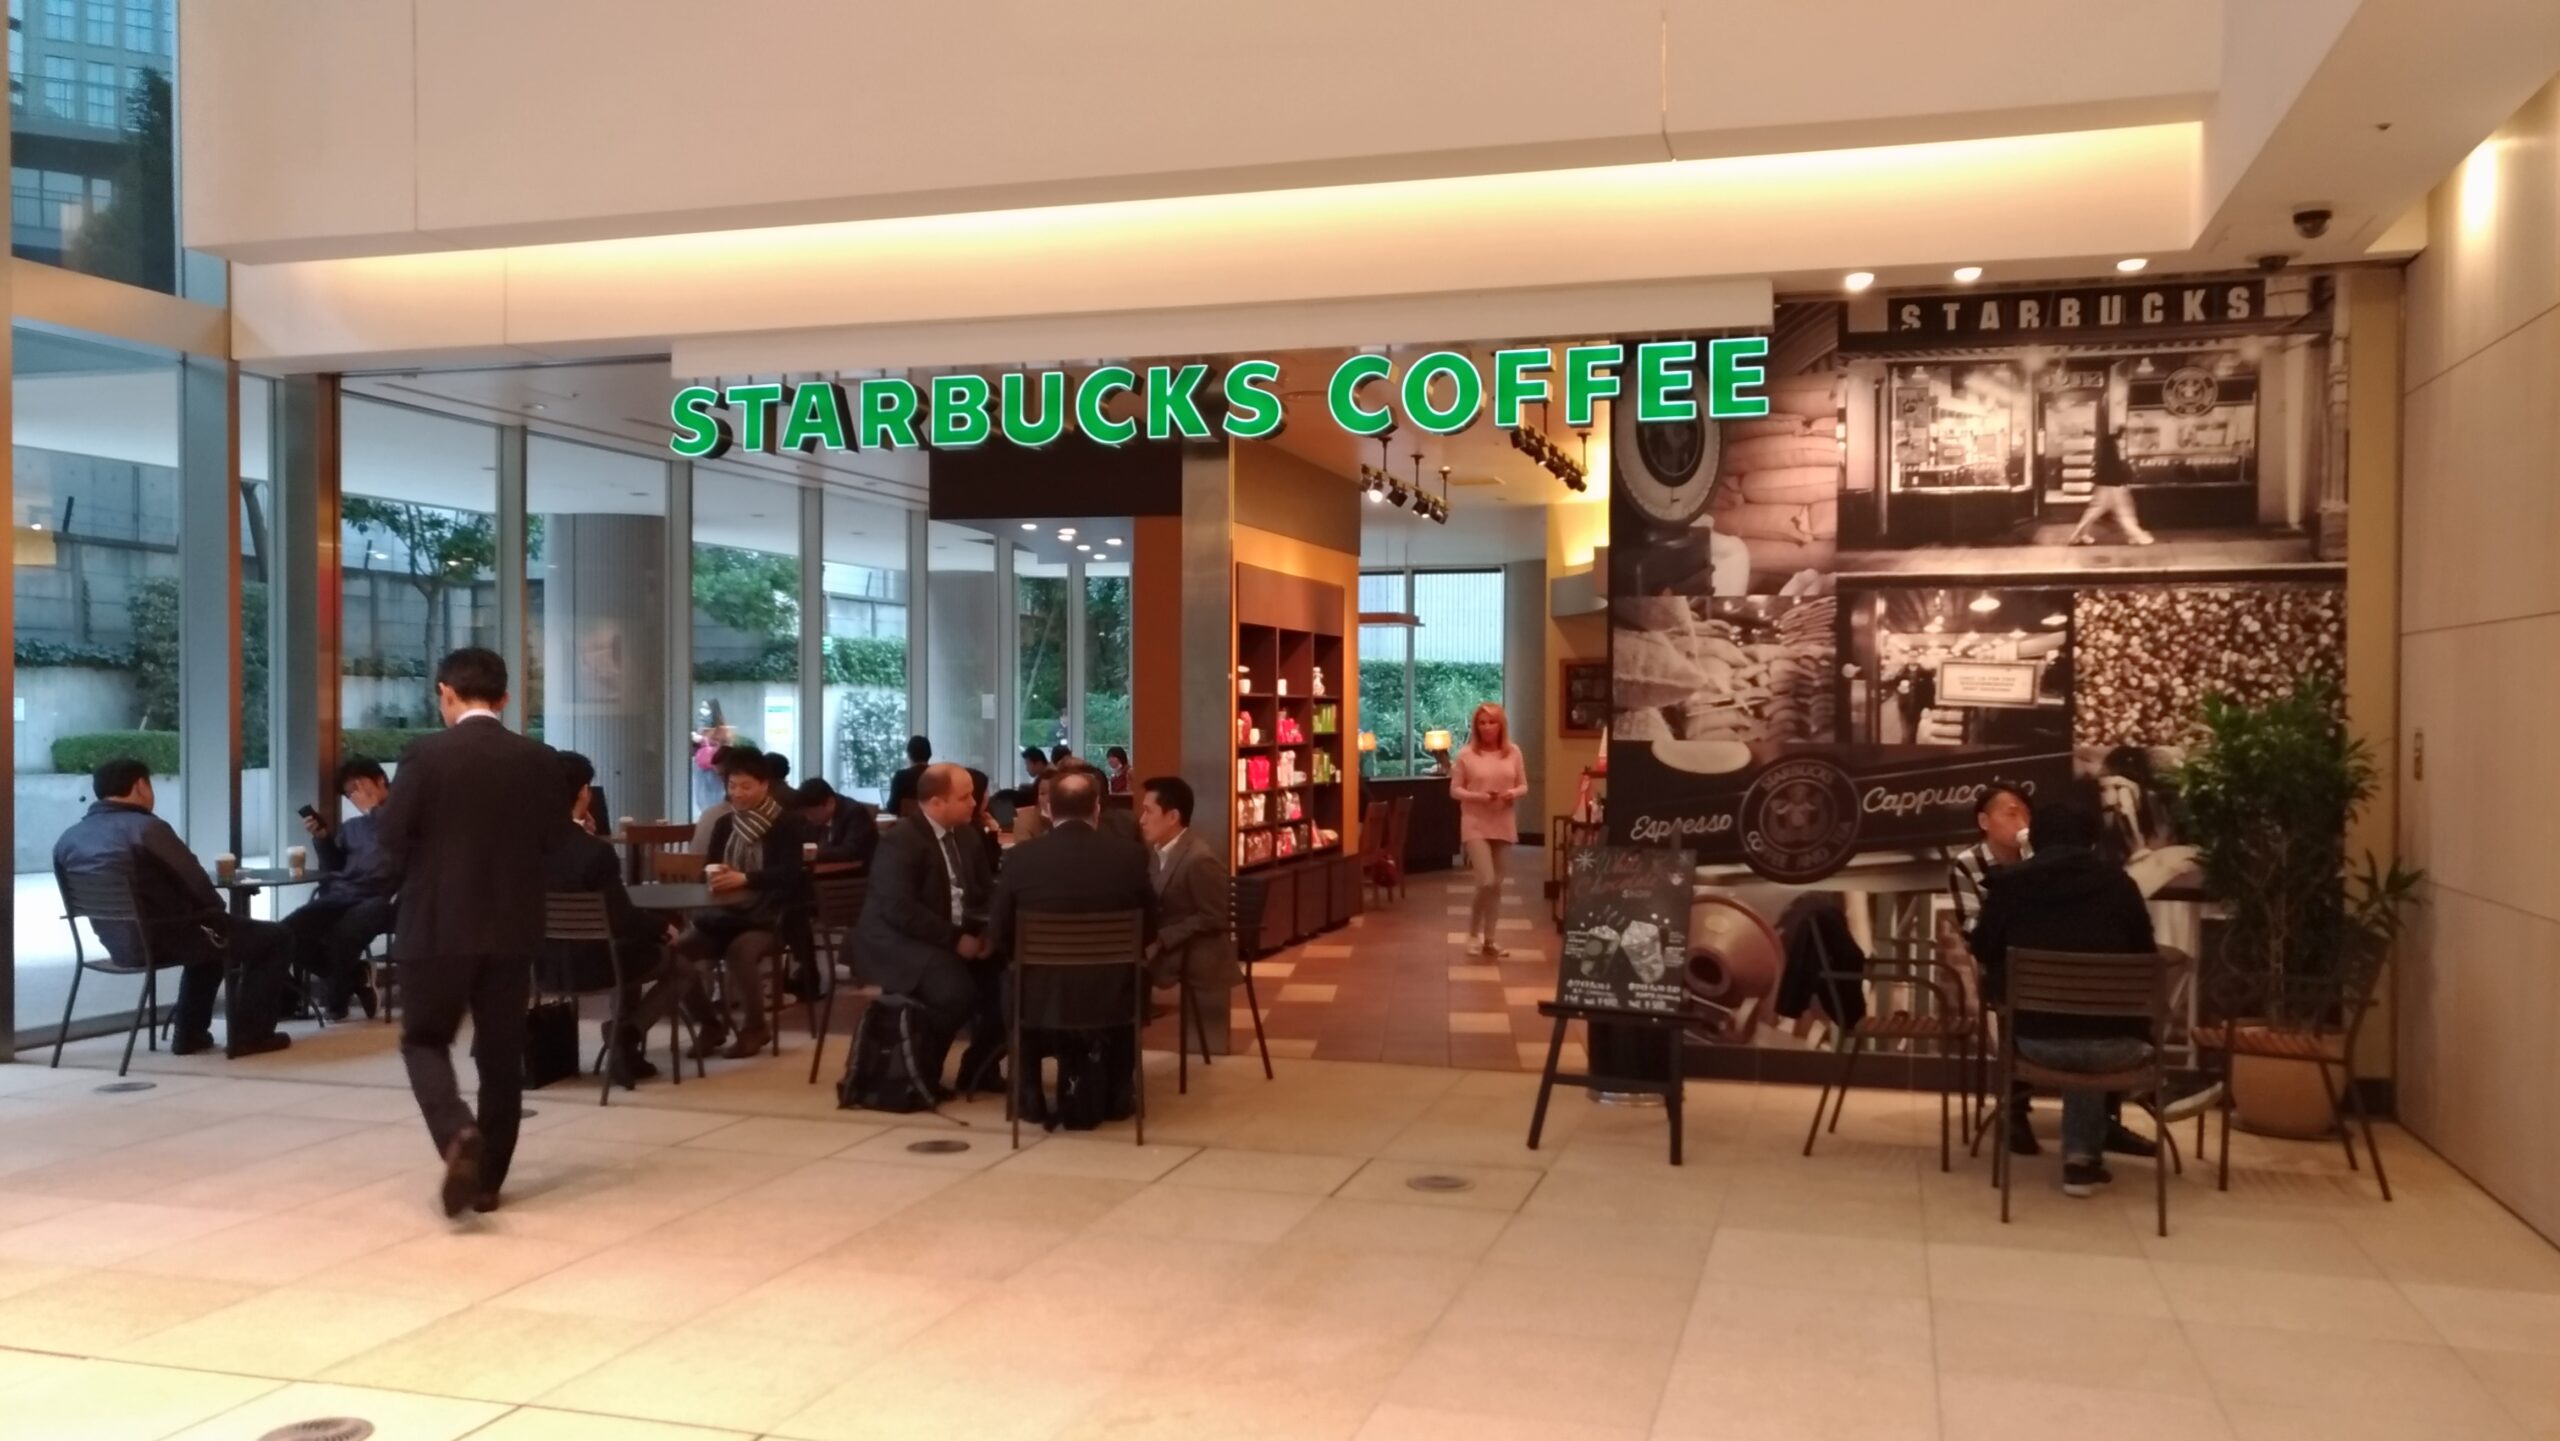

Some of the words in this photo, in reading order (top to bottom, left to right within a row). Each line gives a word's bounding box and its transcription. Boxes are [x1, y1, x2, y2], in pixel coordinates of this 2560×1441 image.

[1900, 286, 2250, 332] STARBUCKS
[669, 359, 1284, 458] STARBUCKS
[1327, 335, 1771, 435] COFFEE
[1862, 774, 2036, 817] Cappucco
[1630, 814, 1733, 844] Espresso
